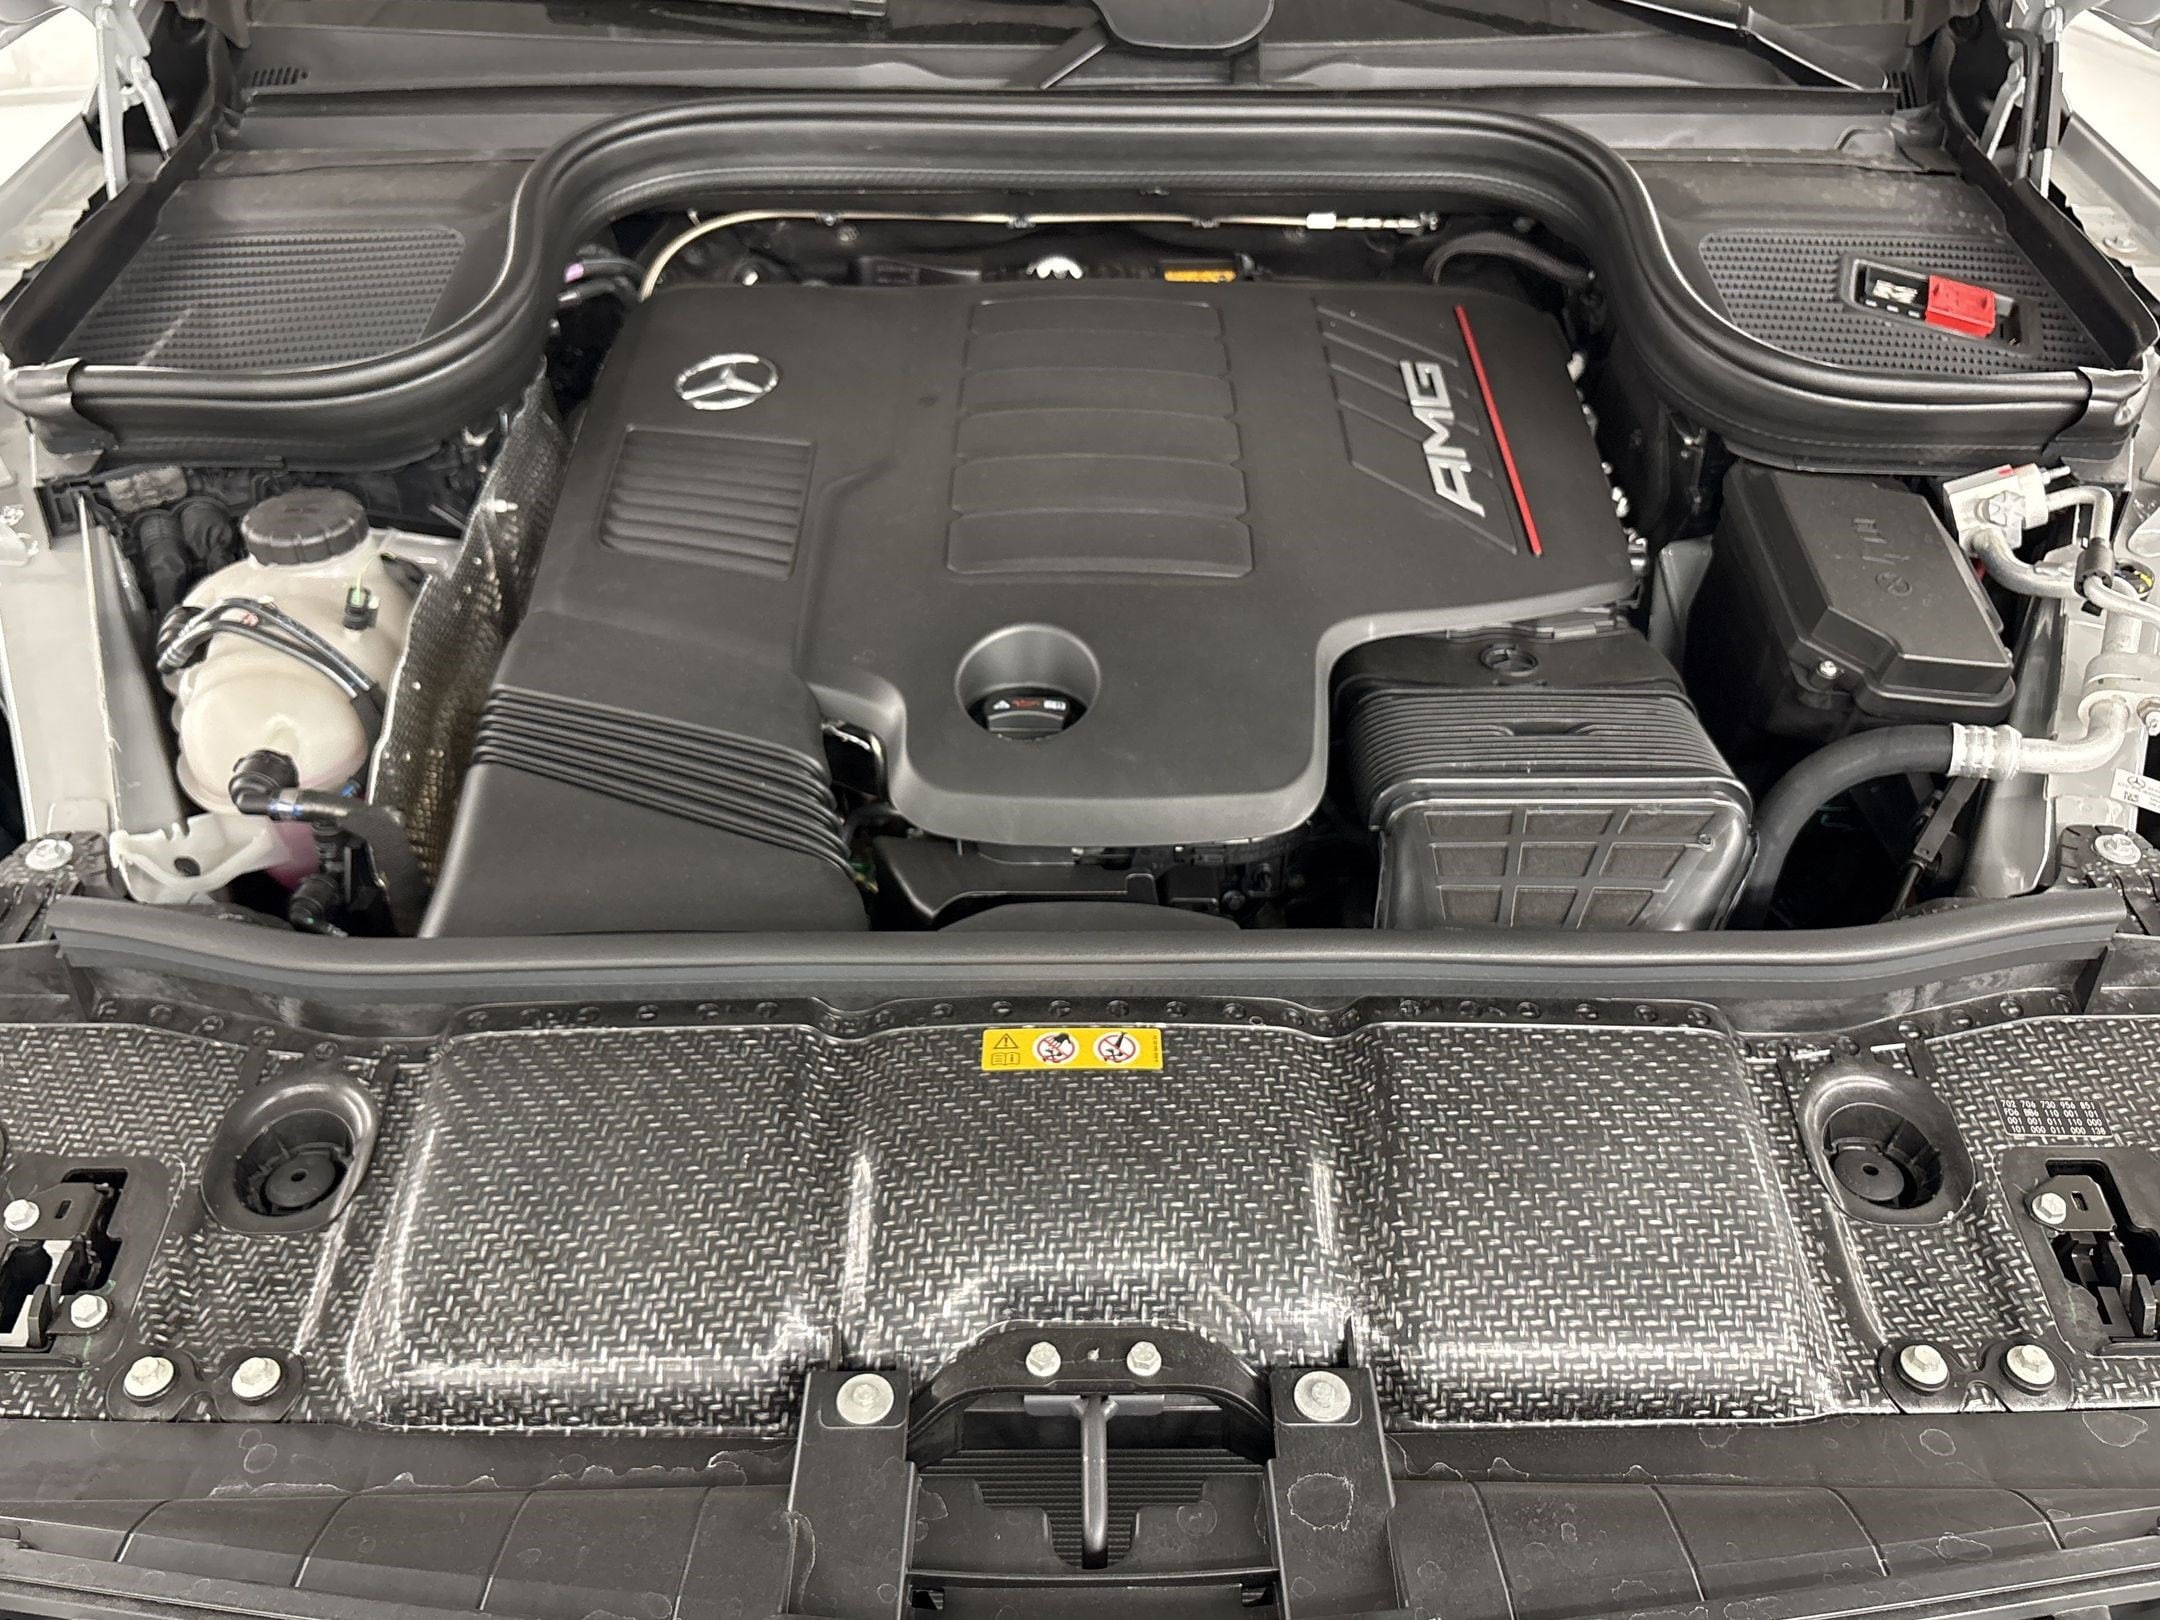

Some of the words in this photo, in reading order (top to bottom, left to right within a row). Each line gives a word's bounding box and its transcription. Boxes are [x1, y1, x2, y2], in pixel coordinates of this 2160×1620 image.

[1400, 361, 1486, 518] AMG
[2000, 1100, 2016, 1108] 702
[2020, 1100, 2036, 1108] 706
[2040, 1100, 2056, 1109] 730
[2060, 1101, 2076, 1110] 956
[2080, 1102, 2095, 1110] 851
[2004, 1108, 2020, 1116] FD6
[2044, 1109, 2060, 1118] 110
[2063, 1110, 2078, 1118] 001
[2084, 1110, 2098, 1118] 101
[2007, 1116, 2022, 1124] 001
[2027, 1117, 2042, 1125] 001
[2046, 1118, 2062, 1126] 011
[2068, 1118, 2082, 1126] 110
[2086, 1118, 2102, 1126] 000
[2012, 1125, 2026, 1133] 101
[2030, 1126, 2046, 1134] 000
[2050, 1126, 2066, 1134] 011
[2070, 1126, 2086, 1134] 000
[2092, 1127, 2106, 1135] 138
